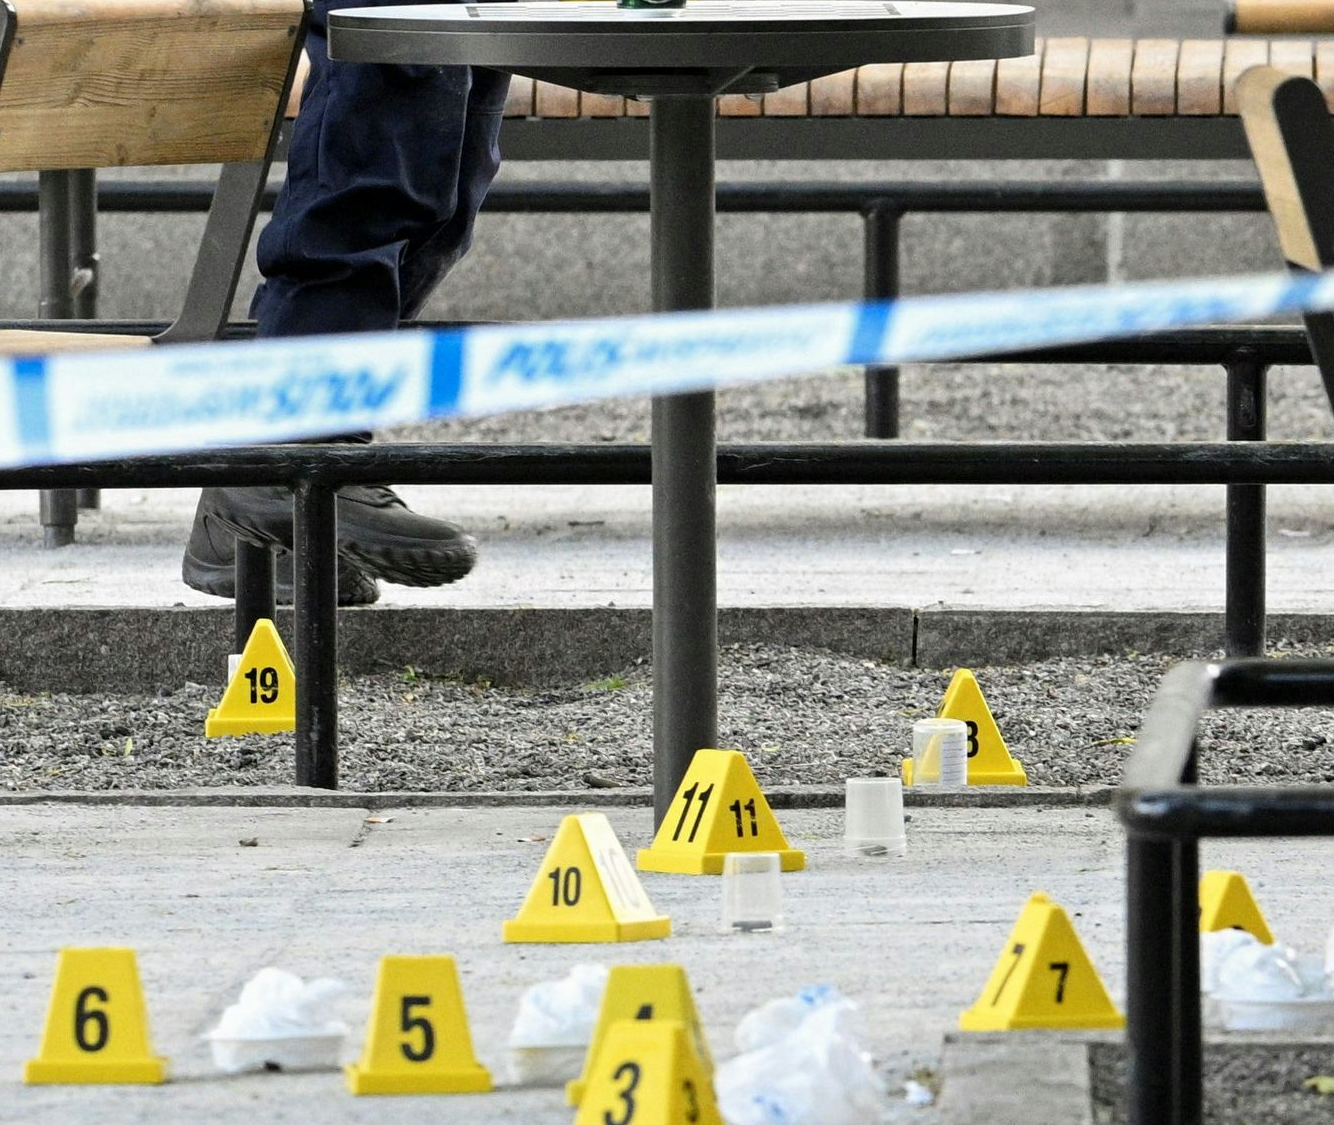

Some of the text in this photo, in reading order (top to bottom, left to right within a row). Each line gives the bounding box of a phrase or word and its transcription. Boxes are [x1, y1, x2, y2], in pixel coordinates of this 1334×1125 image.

[245, 667, 279, 704] 19
[672, 782, 714, 842] 11
[729, 798, 758, 838] 11
[548, 866, 582, 907] 10
[1049, 961, 1070, 1005] 7
[74, 986, 110, 1053] 6
[400, 995, 435, 1063] 5
[603, 1061, 641, 1125] 3
